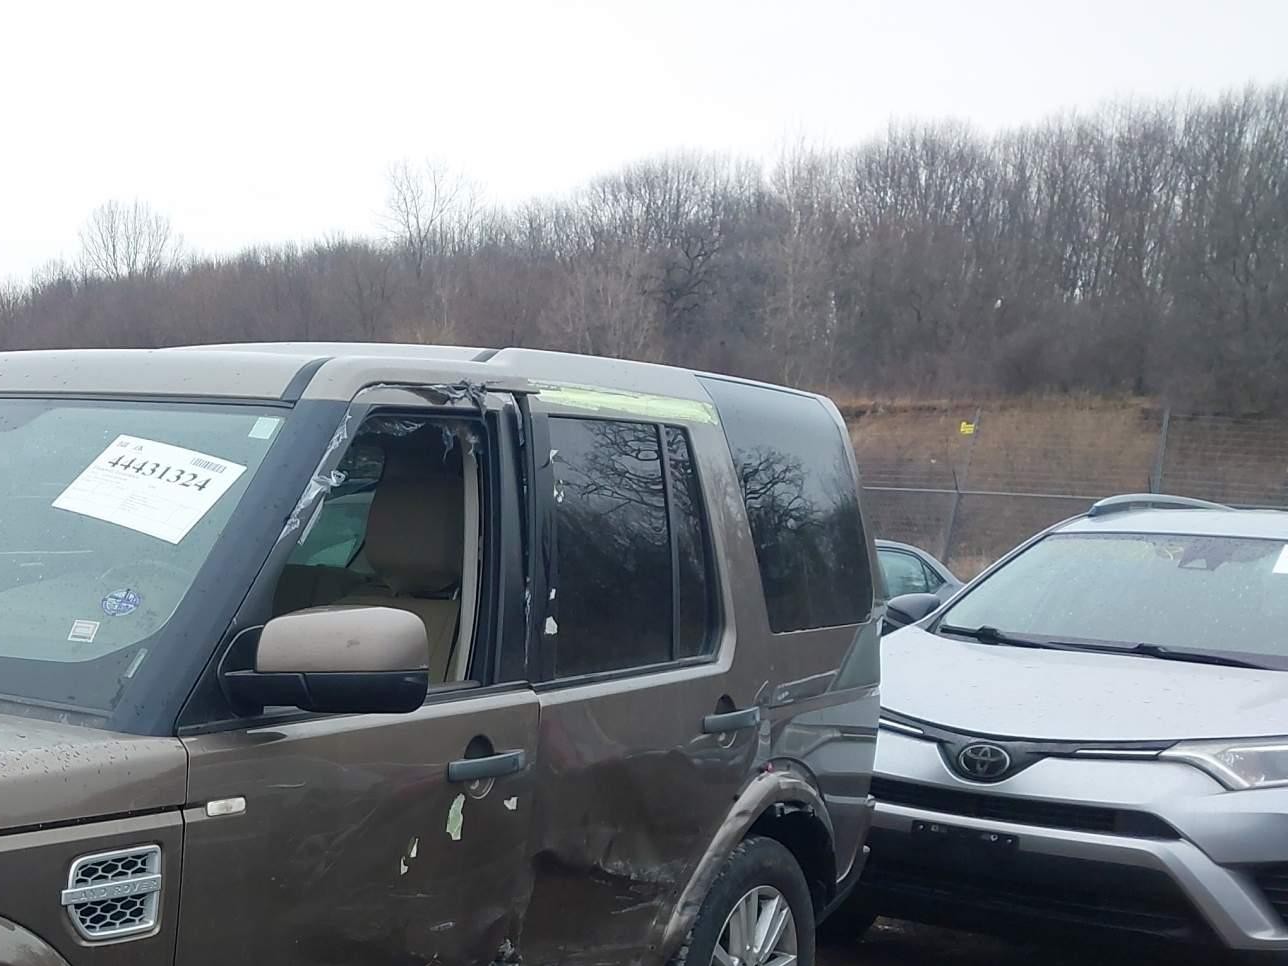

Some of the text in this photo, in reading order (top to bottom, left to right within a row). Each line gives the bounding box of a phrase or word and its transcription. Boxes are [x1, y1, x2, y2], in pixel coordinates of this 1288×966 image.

[108, 455, 212, 491] 44431324
[71, 880, 158, 902] LAND ROVER
